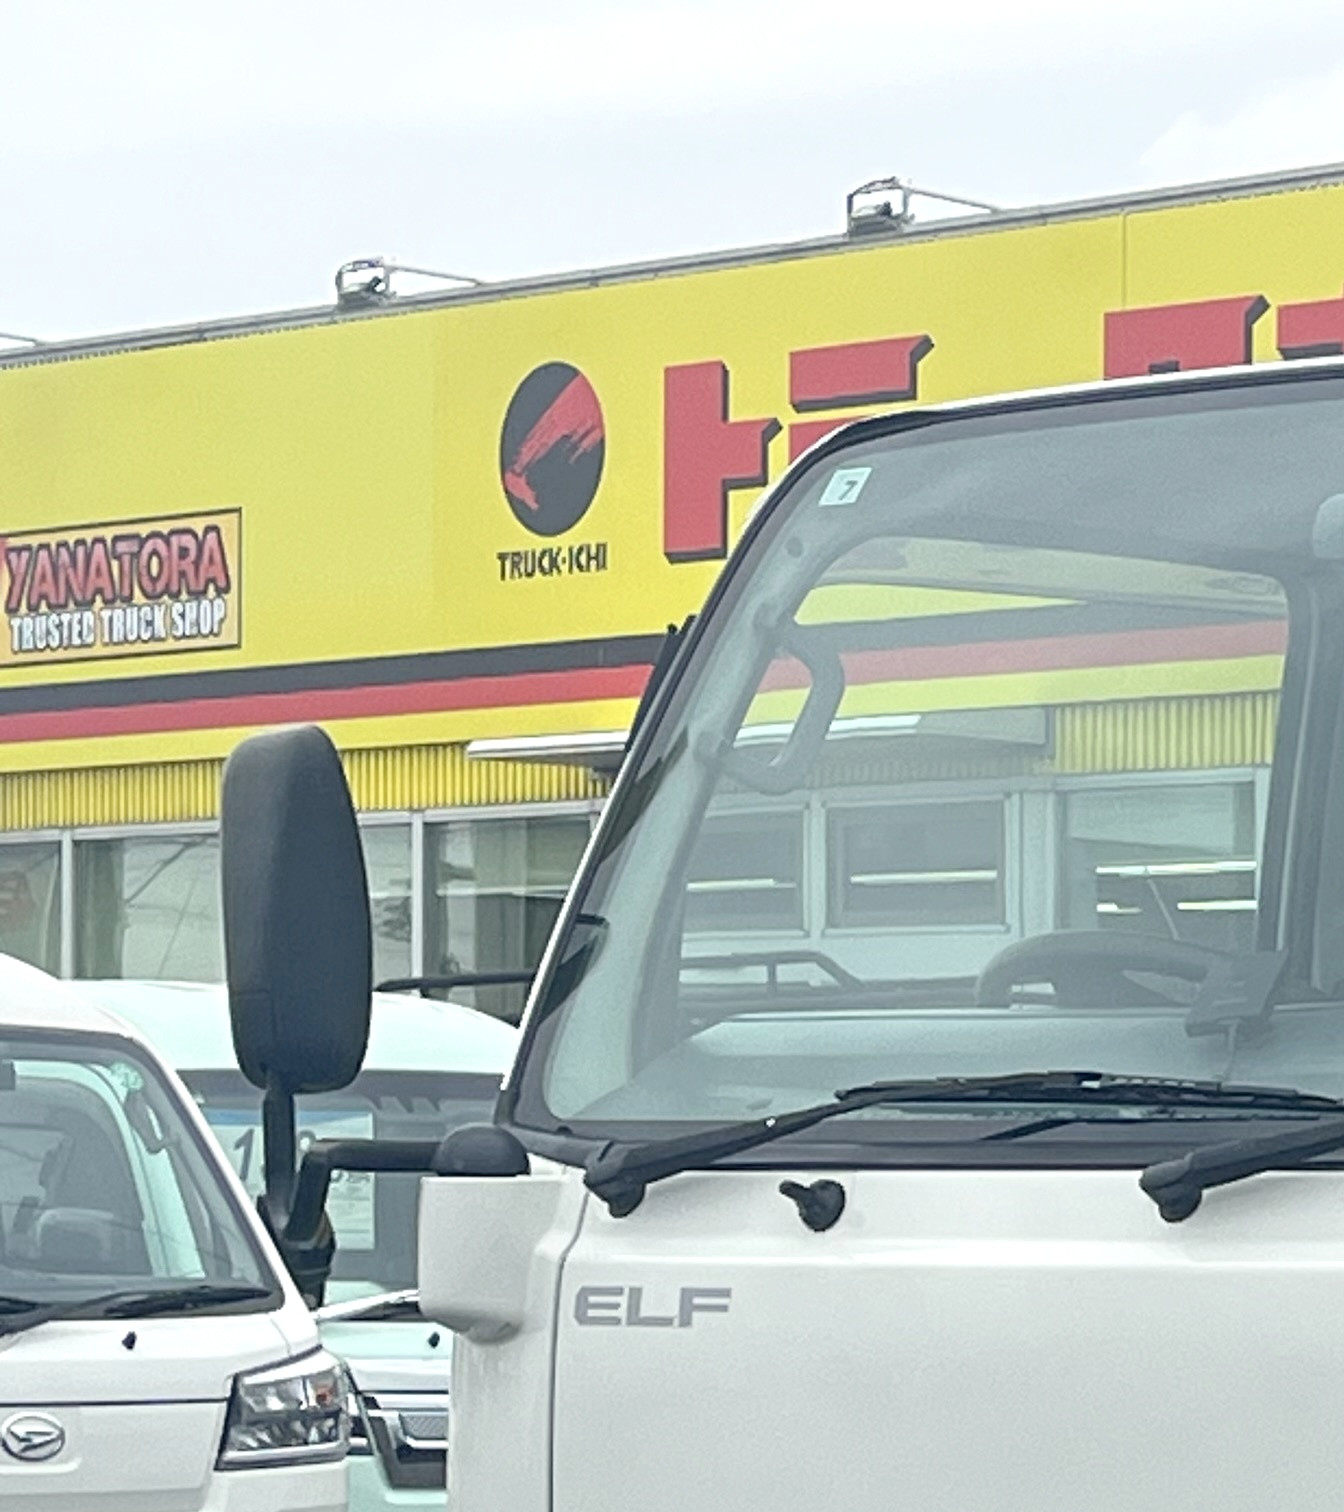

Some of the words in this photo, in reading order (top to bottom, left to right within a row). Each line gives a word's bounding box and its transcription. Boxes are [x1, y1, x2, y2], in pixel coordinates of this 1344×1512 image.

[5, 524, 231, 614] YANATORA
[9, 609, 96, 653] TRUSTED
[100, 602, 168, 645] TRUCK
[170, 596, 226, 640] SHOP
[574, 1285, 732, 1328] ELF
